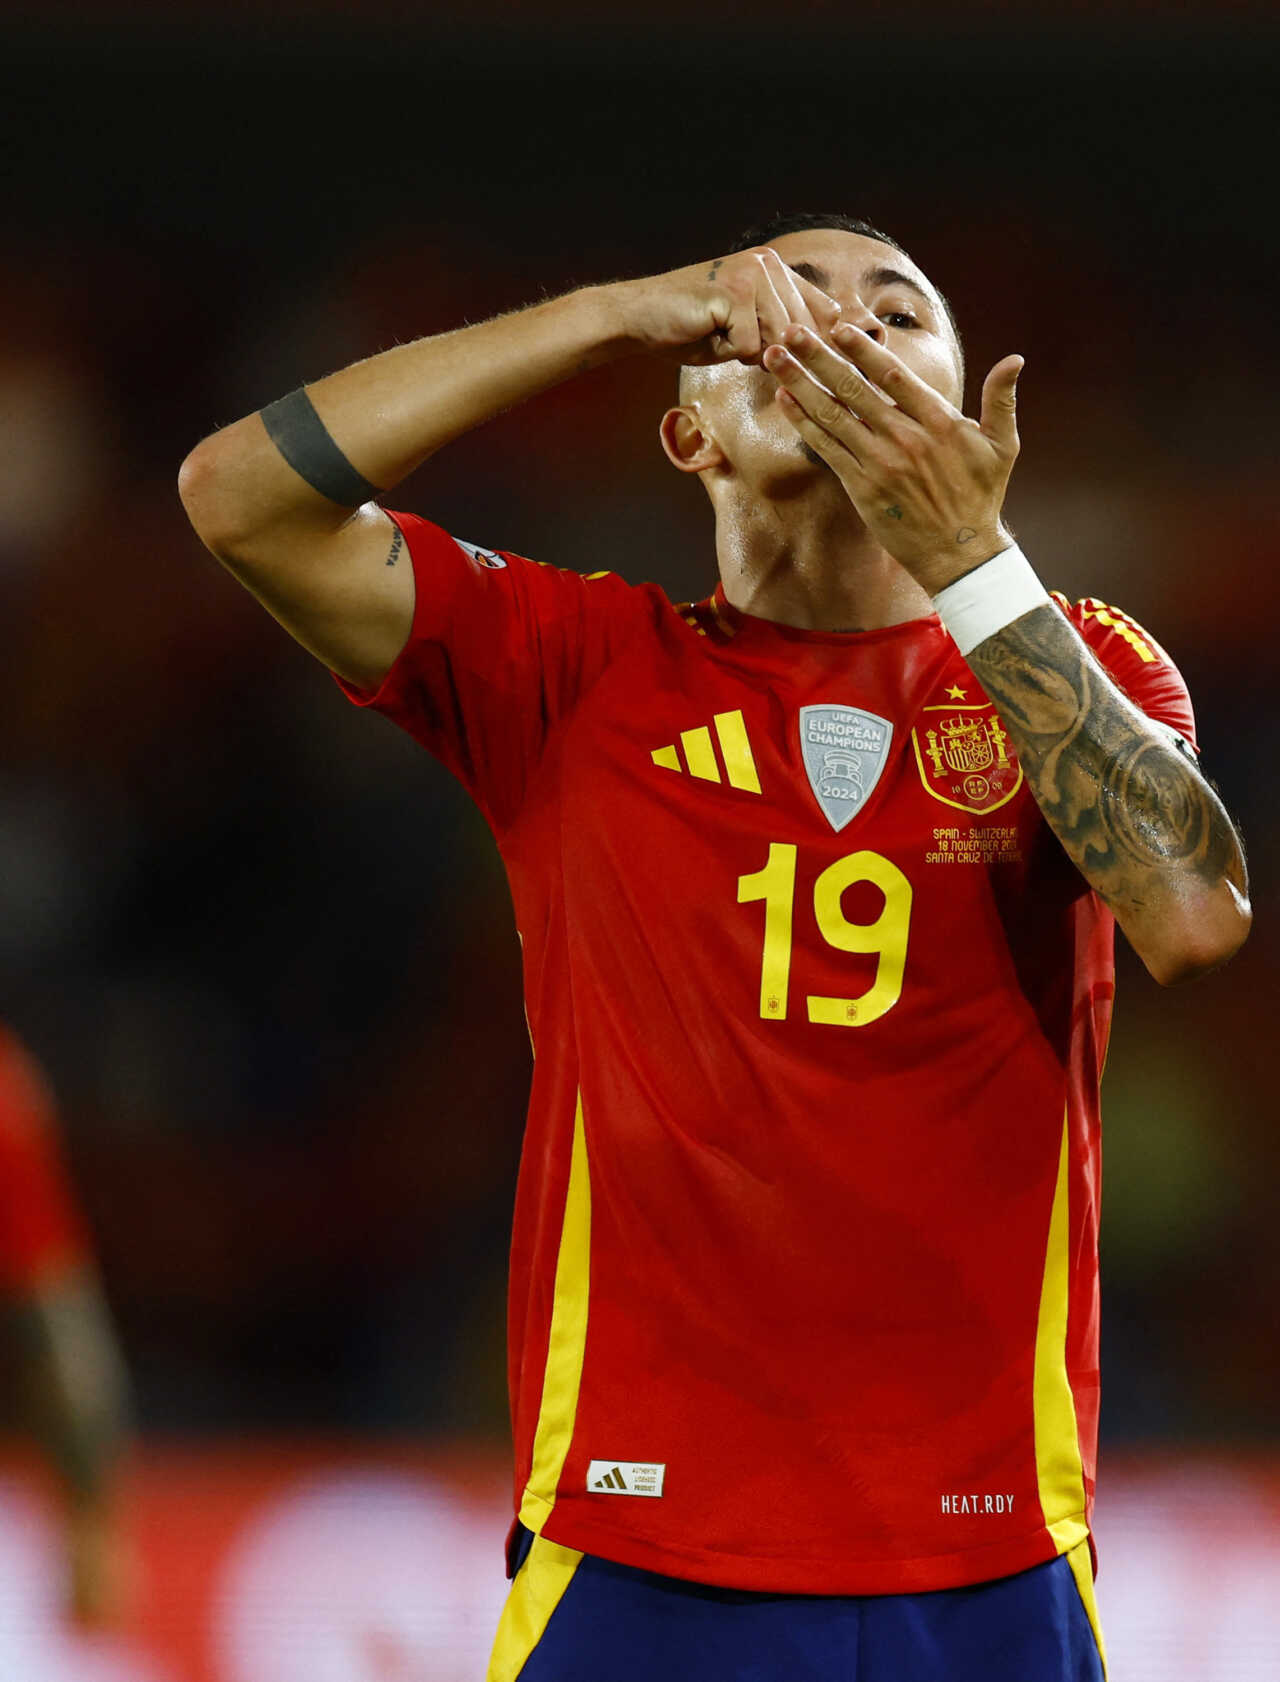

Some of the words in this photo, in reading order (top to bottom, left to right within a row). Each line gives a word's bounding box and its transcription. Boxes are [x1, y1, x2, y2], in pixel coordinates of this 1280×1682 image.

[832, 712, 860, 725] UEFA
[808, 720, 881, 740] EUROPEAN
[808, 732, 881, 752] CHAMPIONS
[823, 786, 858, 800] 2024
[933, 828, 960, 840] SPAIN
[938, 841, 948, 851] 18
[952, 841, 998, 851] NOVEMBER
[925, 852, 954, 863] SANTA
[957, 852, 980, 863] CRUZ
[737, 842, 913, 1027] 19
[941, 1494, 1014, 1513] HEAT.RDY
